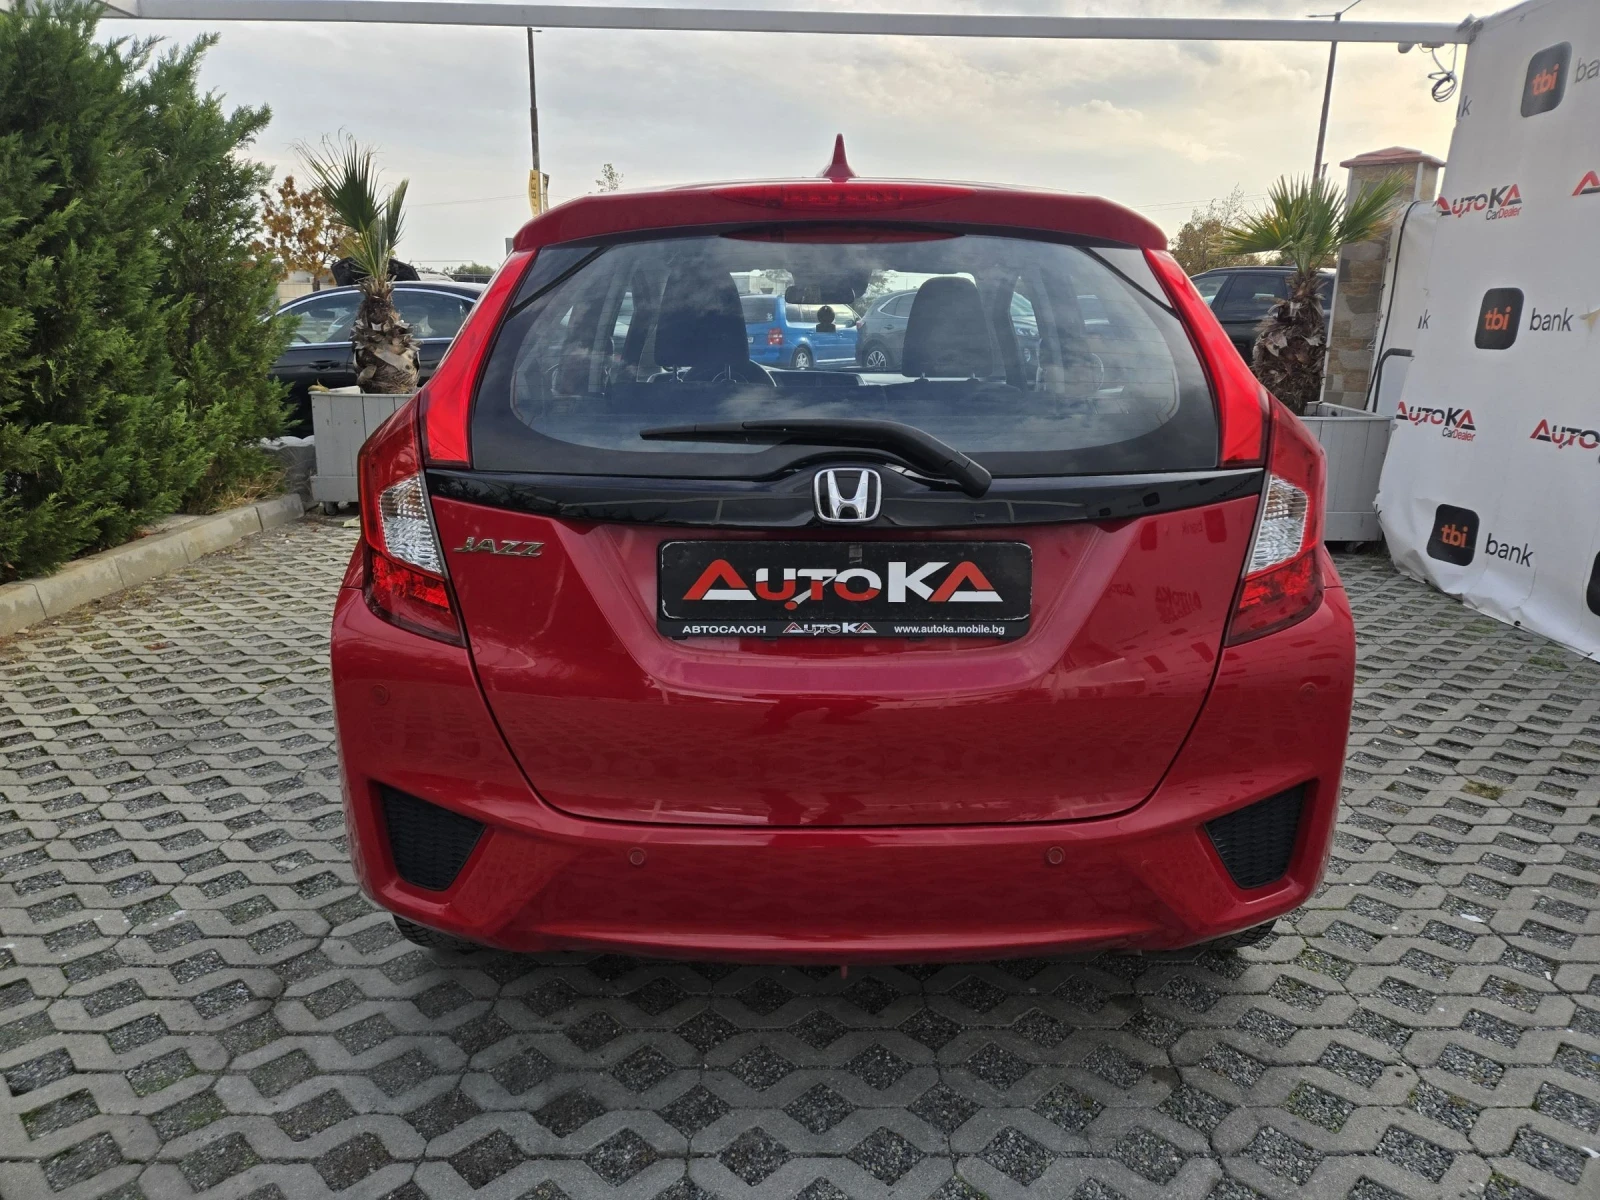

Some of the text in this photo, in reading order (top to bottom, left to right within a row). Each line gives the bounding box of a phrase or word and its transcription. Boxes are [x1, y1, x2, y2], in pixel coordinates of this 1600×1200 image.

[1532, 63, 1560, 96] tbi
[1484, 306, 1574, 332] tbi bank
[453, 536, 545, 558] JAZZ
[1441, 523, 1534, 568] tbi bank
[682, 625, 767, 635] АВТОСАЛОН
[894, 624, 1005, 636] www.autoka.mobile.bg
